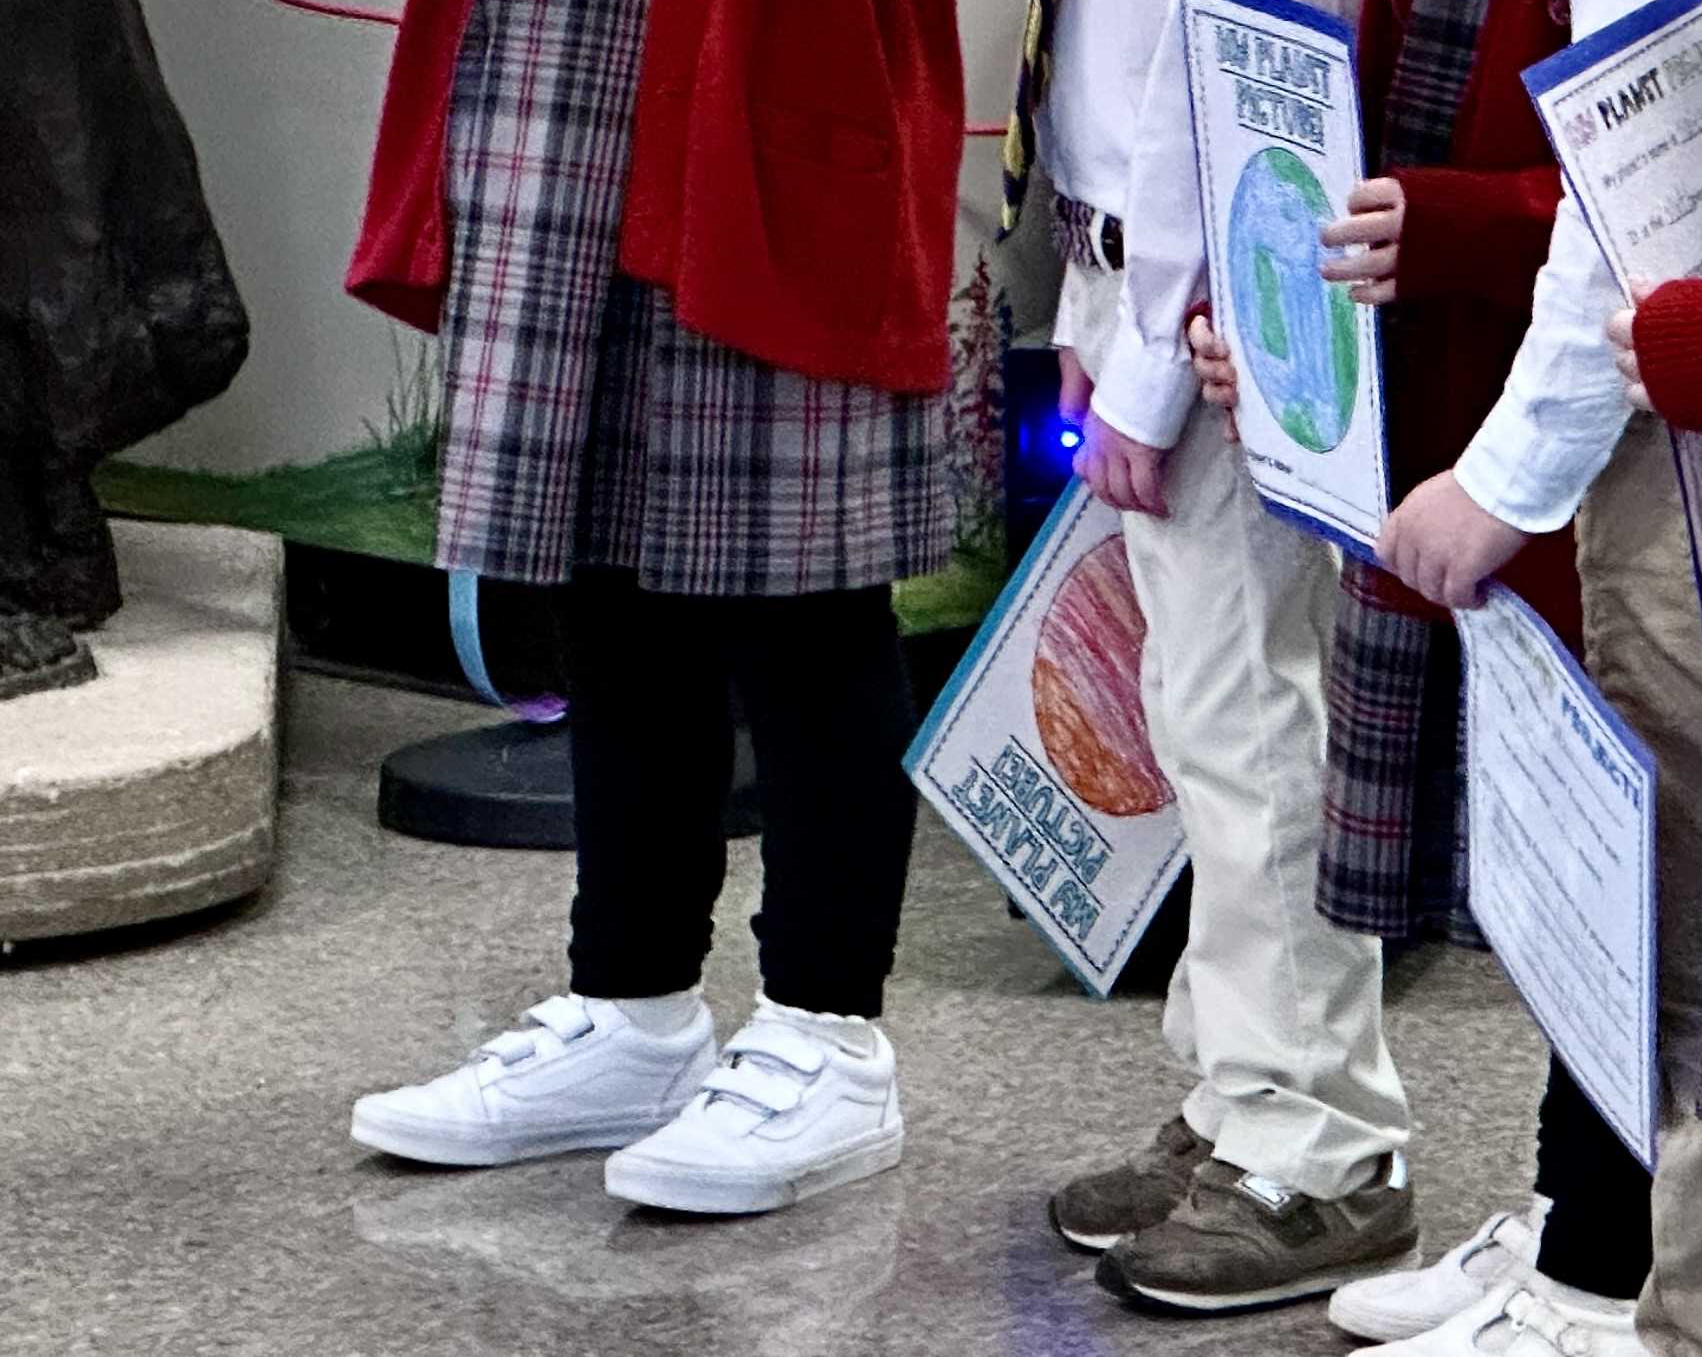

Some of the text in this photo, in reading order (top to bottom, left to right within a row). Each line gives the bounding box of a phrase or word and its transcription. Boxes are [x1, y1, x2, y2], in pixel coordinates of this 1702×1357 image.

[1597, 68, 1666, 131] PLANET
[951, 768, 1101, 942] MY PLANET
